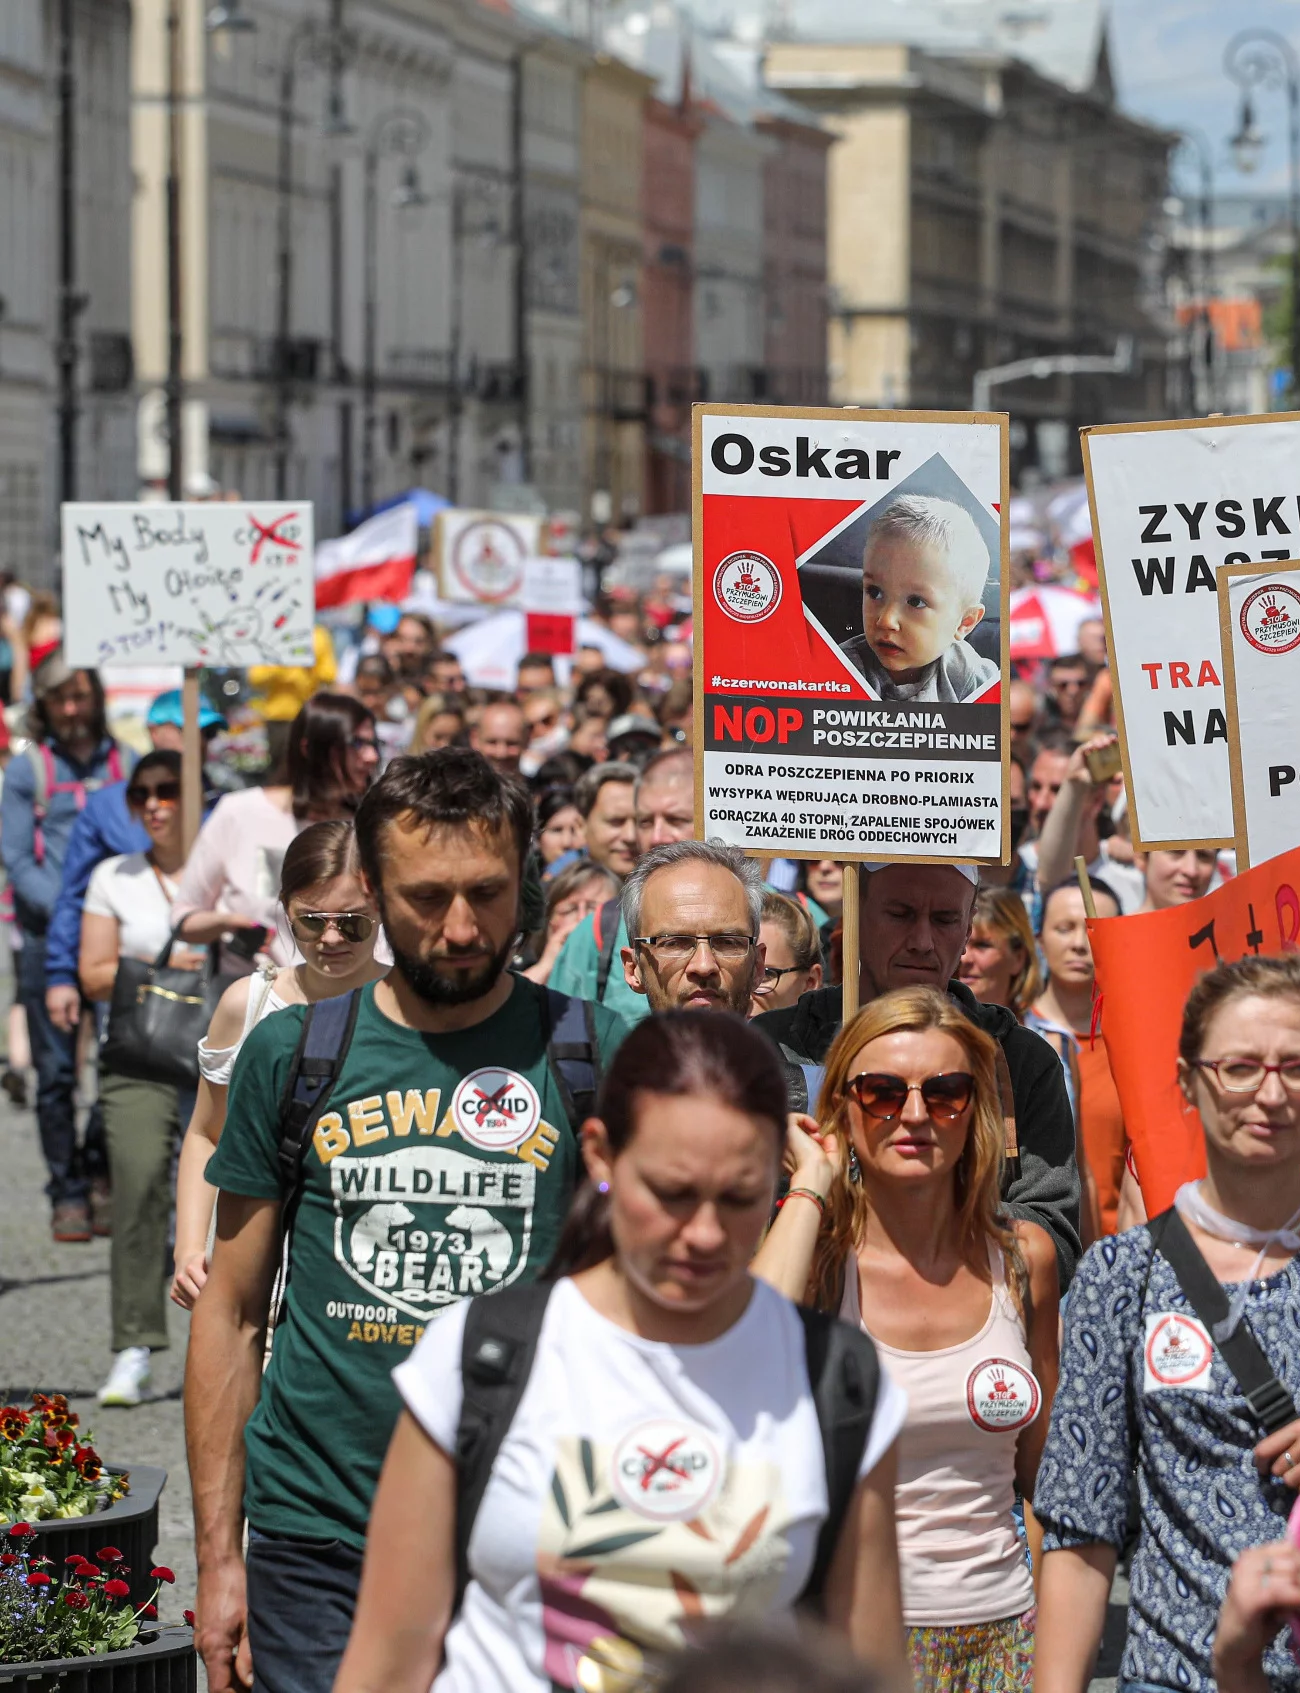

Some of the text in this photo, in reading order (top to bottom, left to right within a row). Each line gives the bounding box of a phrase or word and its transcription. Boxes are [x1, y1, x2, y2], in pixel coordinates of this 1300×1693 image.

[710, 433, 901, 481] Oskar
[76, 510, 208, 572] My Body
[107, 581, 152, 626] My
[726, 588, 768, 601] PRZYMUSOWI
[728, 596, 763, 607] SZCZEPIEŃ
[1255, 619, 1300, 634] PRZYMUSOWI
[1267, 615, 1284, 624] STOP
[1260, 627, 1297, 641] SZCZEPIEŃ
[711, 675, 851, 694] #czerwonakartka
[1141, 660, 1221, 689] TRA
[714, 705, 804, 744] NOP
[813, 710, 946, 729] POWIKŁANIA
[1163, 709, 1228, 746] NA
[814, 729, 996, 750] POSZCZEPIENNE
[724, 763, 974, 784] ODRA POSZCZEPIENNA PO PRIORIX
[709, 787, 998, 808] WYSYPKA WĘDRUJĄCA DROBNO-PLAMIASTA
[709, 809, 995, 830] GORĄCZKA 40 STOPNI, ZAPALENIE SPOJÓWEK
[746, 824, 957, 844] ZAKAŻENIE DRÓG ODDECHOWYCH
[462, 1098, 528, 1114] COVID
[340, 1167, 522, 1200] WILDLIFE
[391, 1230, 466, 1253] 1973
[374, 1251, 484, 1292] BEAR
[326, 1301, 397, 1323] OUTDOOR
[980, 1400, 1027, 1408] PRZYMUSOWI
[983, 1409, 1023, 1417] SZCZEPIEŃ
